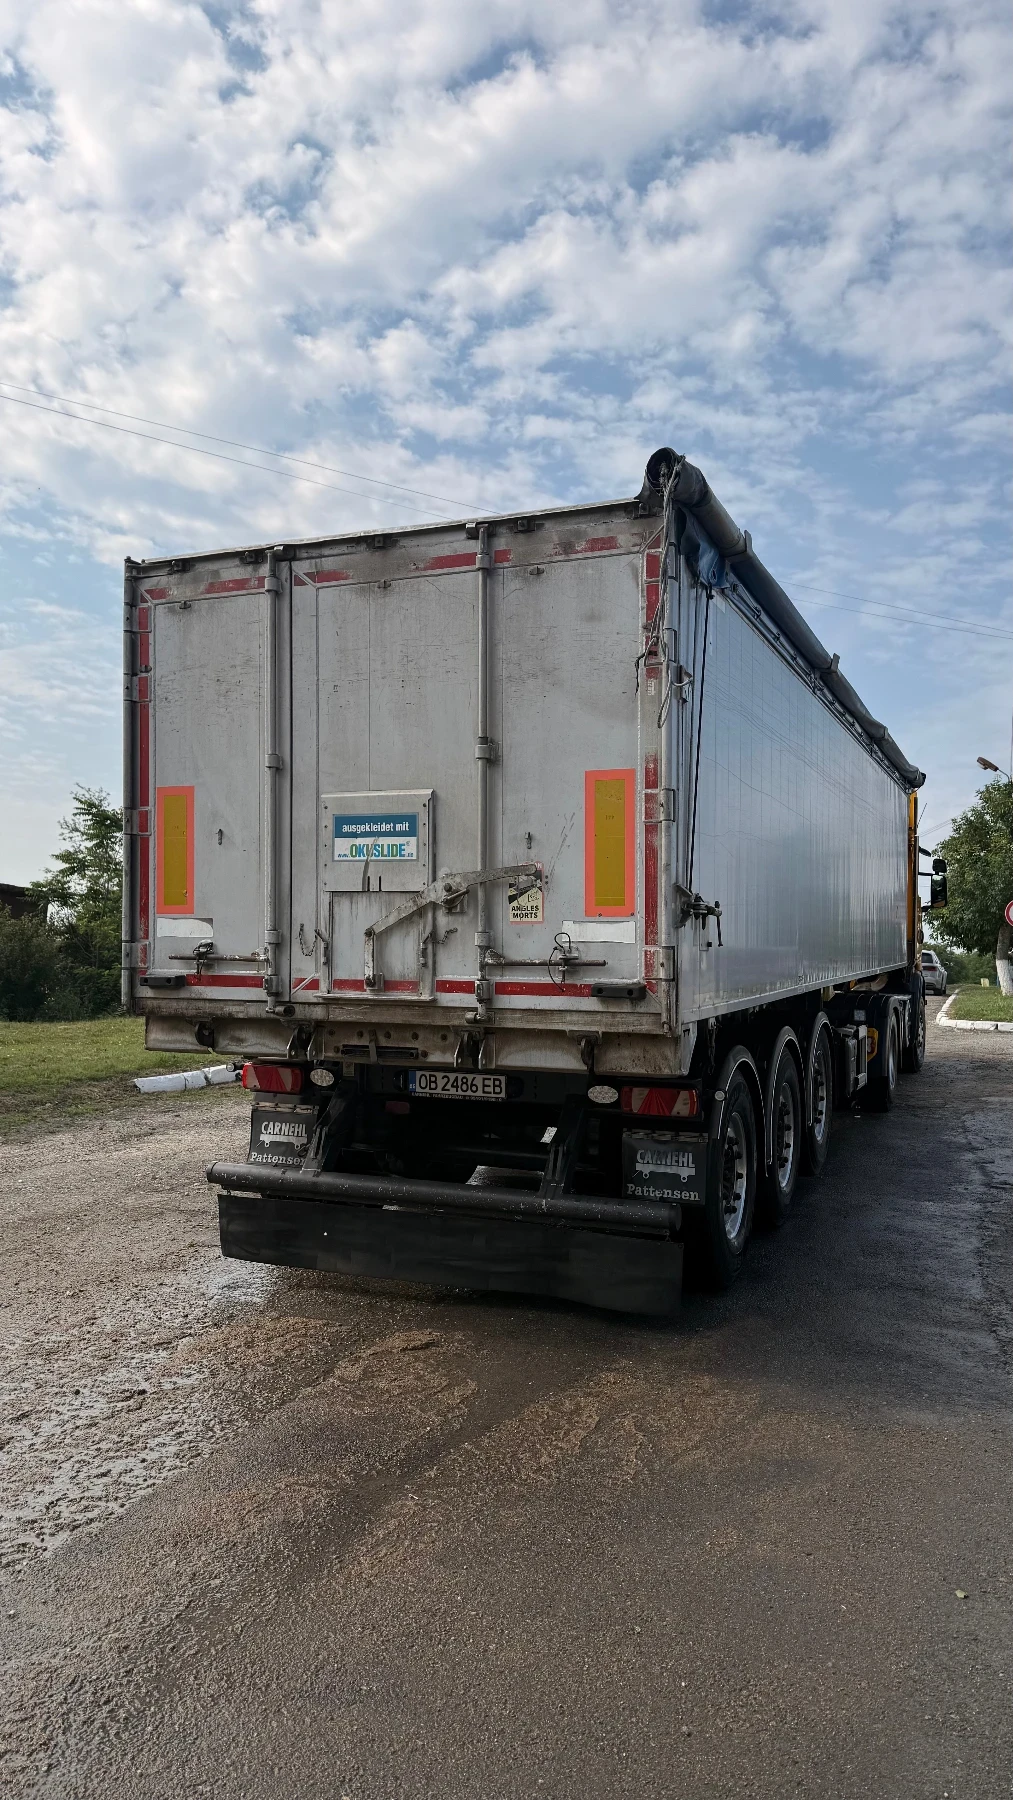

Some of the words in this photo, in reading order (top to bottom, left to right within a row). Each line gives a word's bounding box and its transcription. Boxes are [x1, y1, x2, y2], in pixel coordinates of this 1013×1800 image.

[342, 822, 394, 834] ausgekleidet
[395, 821, 410, 832] mit
[418, 1073, 438, 1091] OB
[441, 1074, 479, 1094] 2486
[482, 1077, 503, 1095] EB
[261, 1121, 308, 1137] CARNEHL
[626, 1183, 701, 1201] Pattensen
